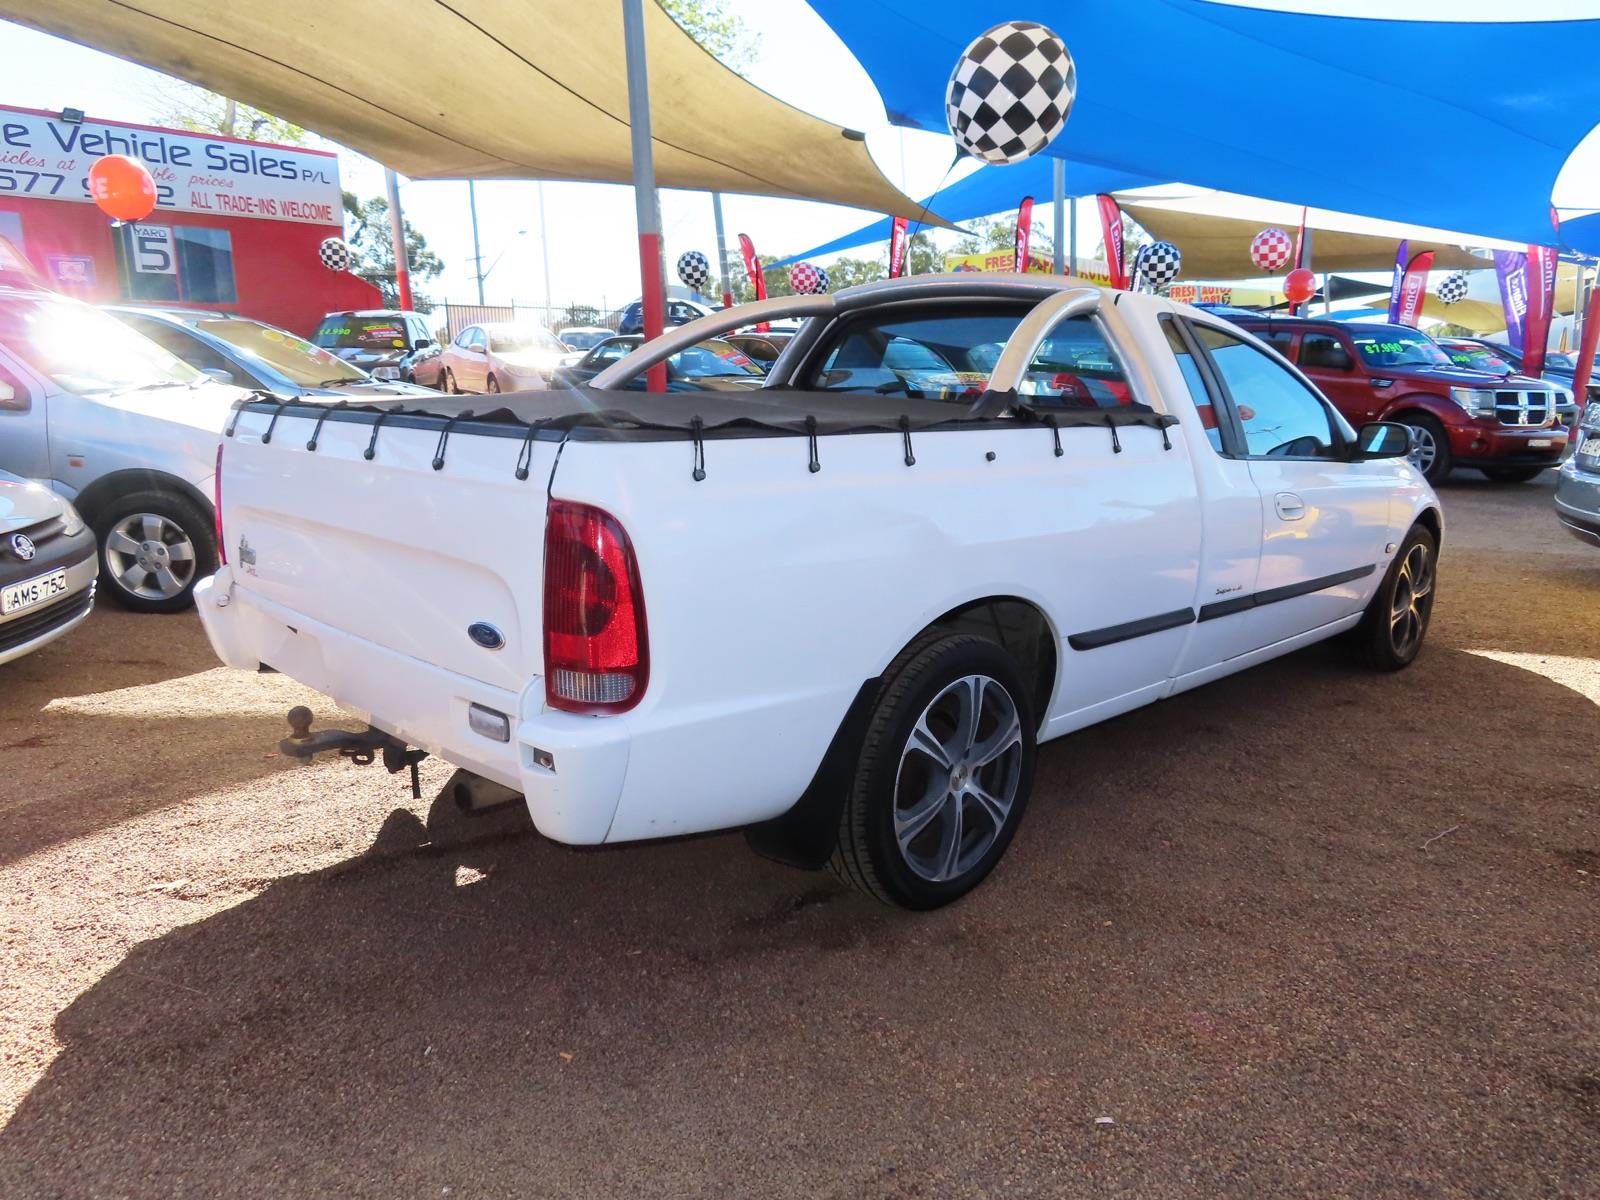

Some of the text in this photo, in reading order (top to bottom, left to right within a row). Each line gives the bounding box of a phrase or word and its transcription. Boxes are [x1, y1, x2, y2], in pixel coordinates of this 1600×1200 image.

[47, 121, 192, 167] Vehicle
[205, 144, 298, 180] Sales
[302, 169, 331, 184] P/L
[57, 159, 77, 171] at
[187, 174, 235, 188] prices
[191, 191, 213, 209] ALL
[215, 193, 278, 215] TRADE-INS
[280, 200, 333, 221] WELCOME
[134, 228, 167, 237] YARD
[138, 236, 171, 271] 5
[985, 255, 1014, 269] FRES
